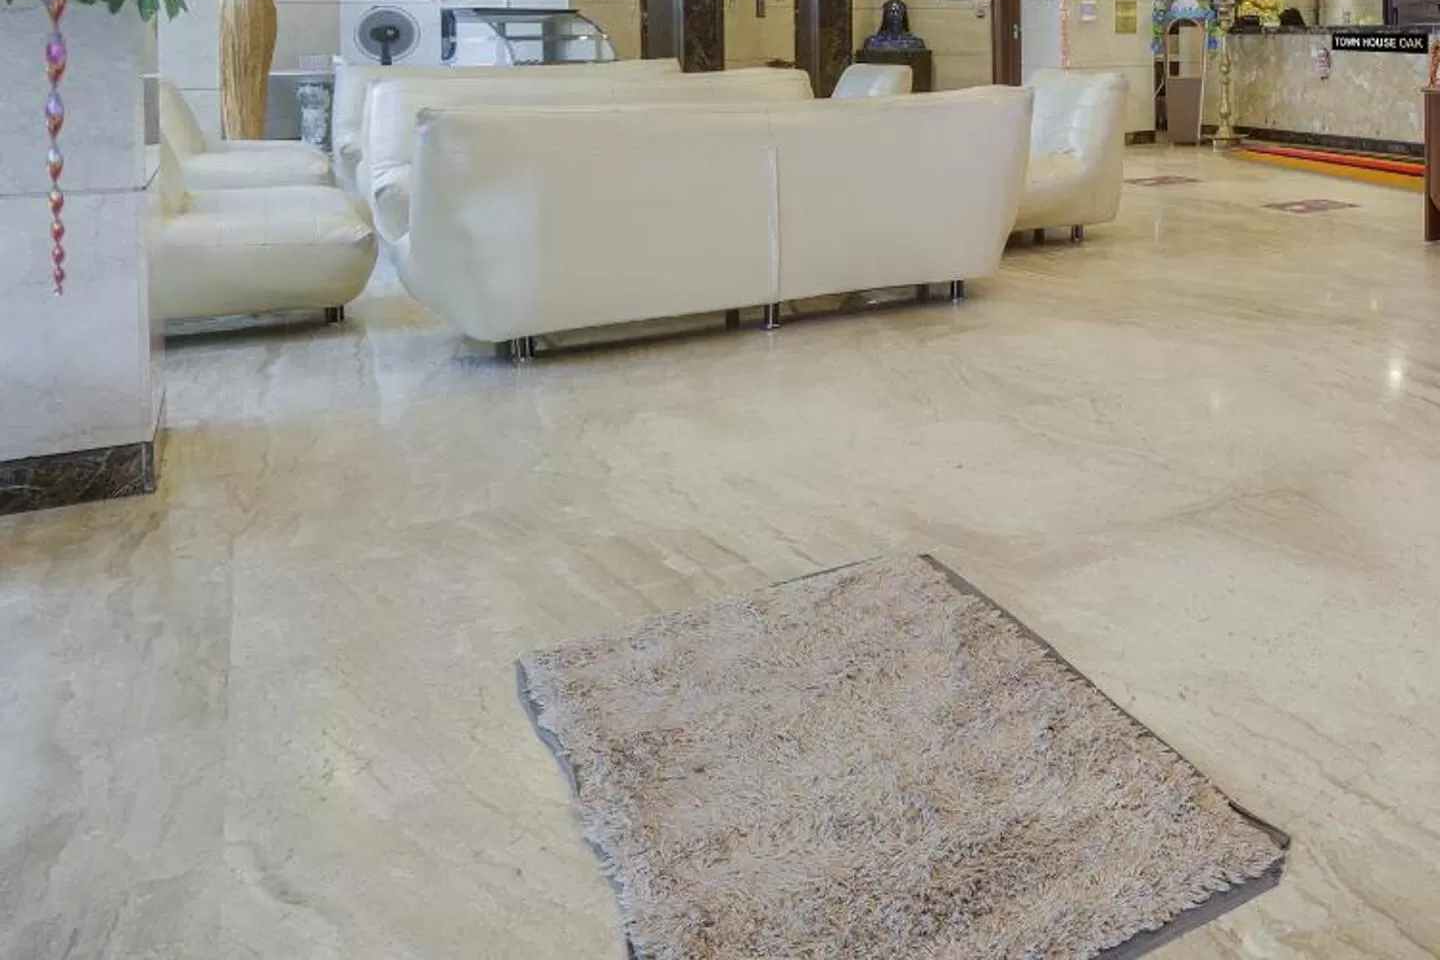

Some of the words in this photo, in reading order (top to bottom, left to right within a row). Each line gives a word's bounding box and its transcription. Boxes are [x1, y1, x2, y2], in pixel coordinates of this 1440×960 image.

[1335, 36, 1360, 47] TOWN
[1362, 36, 1397, 48] HOUSE
[1399, 37, 1424, 49] OAK
